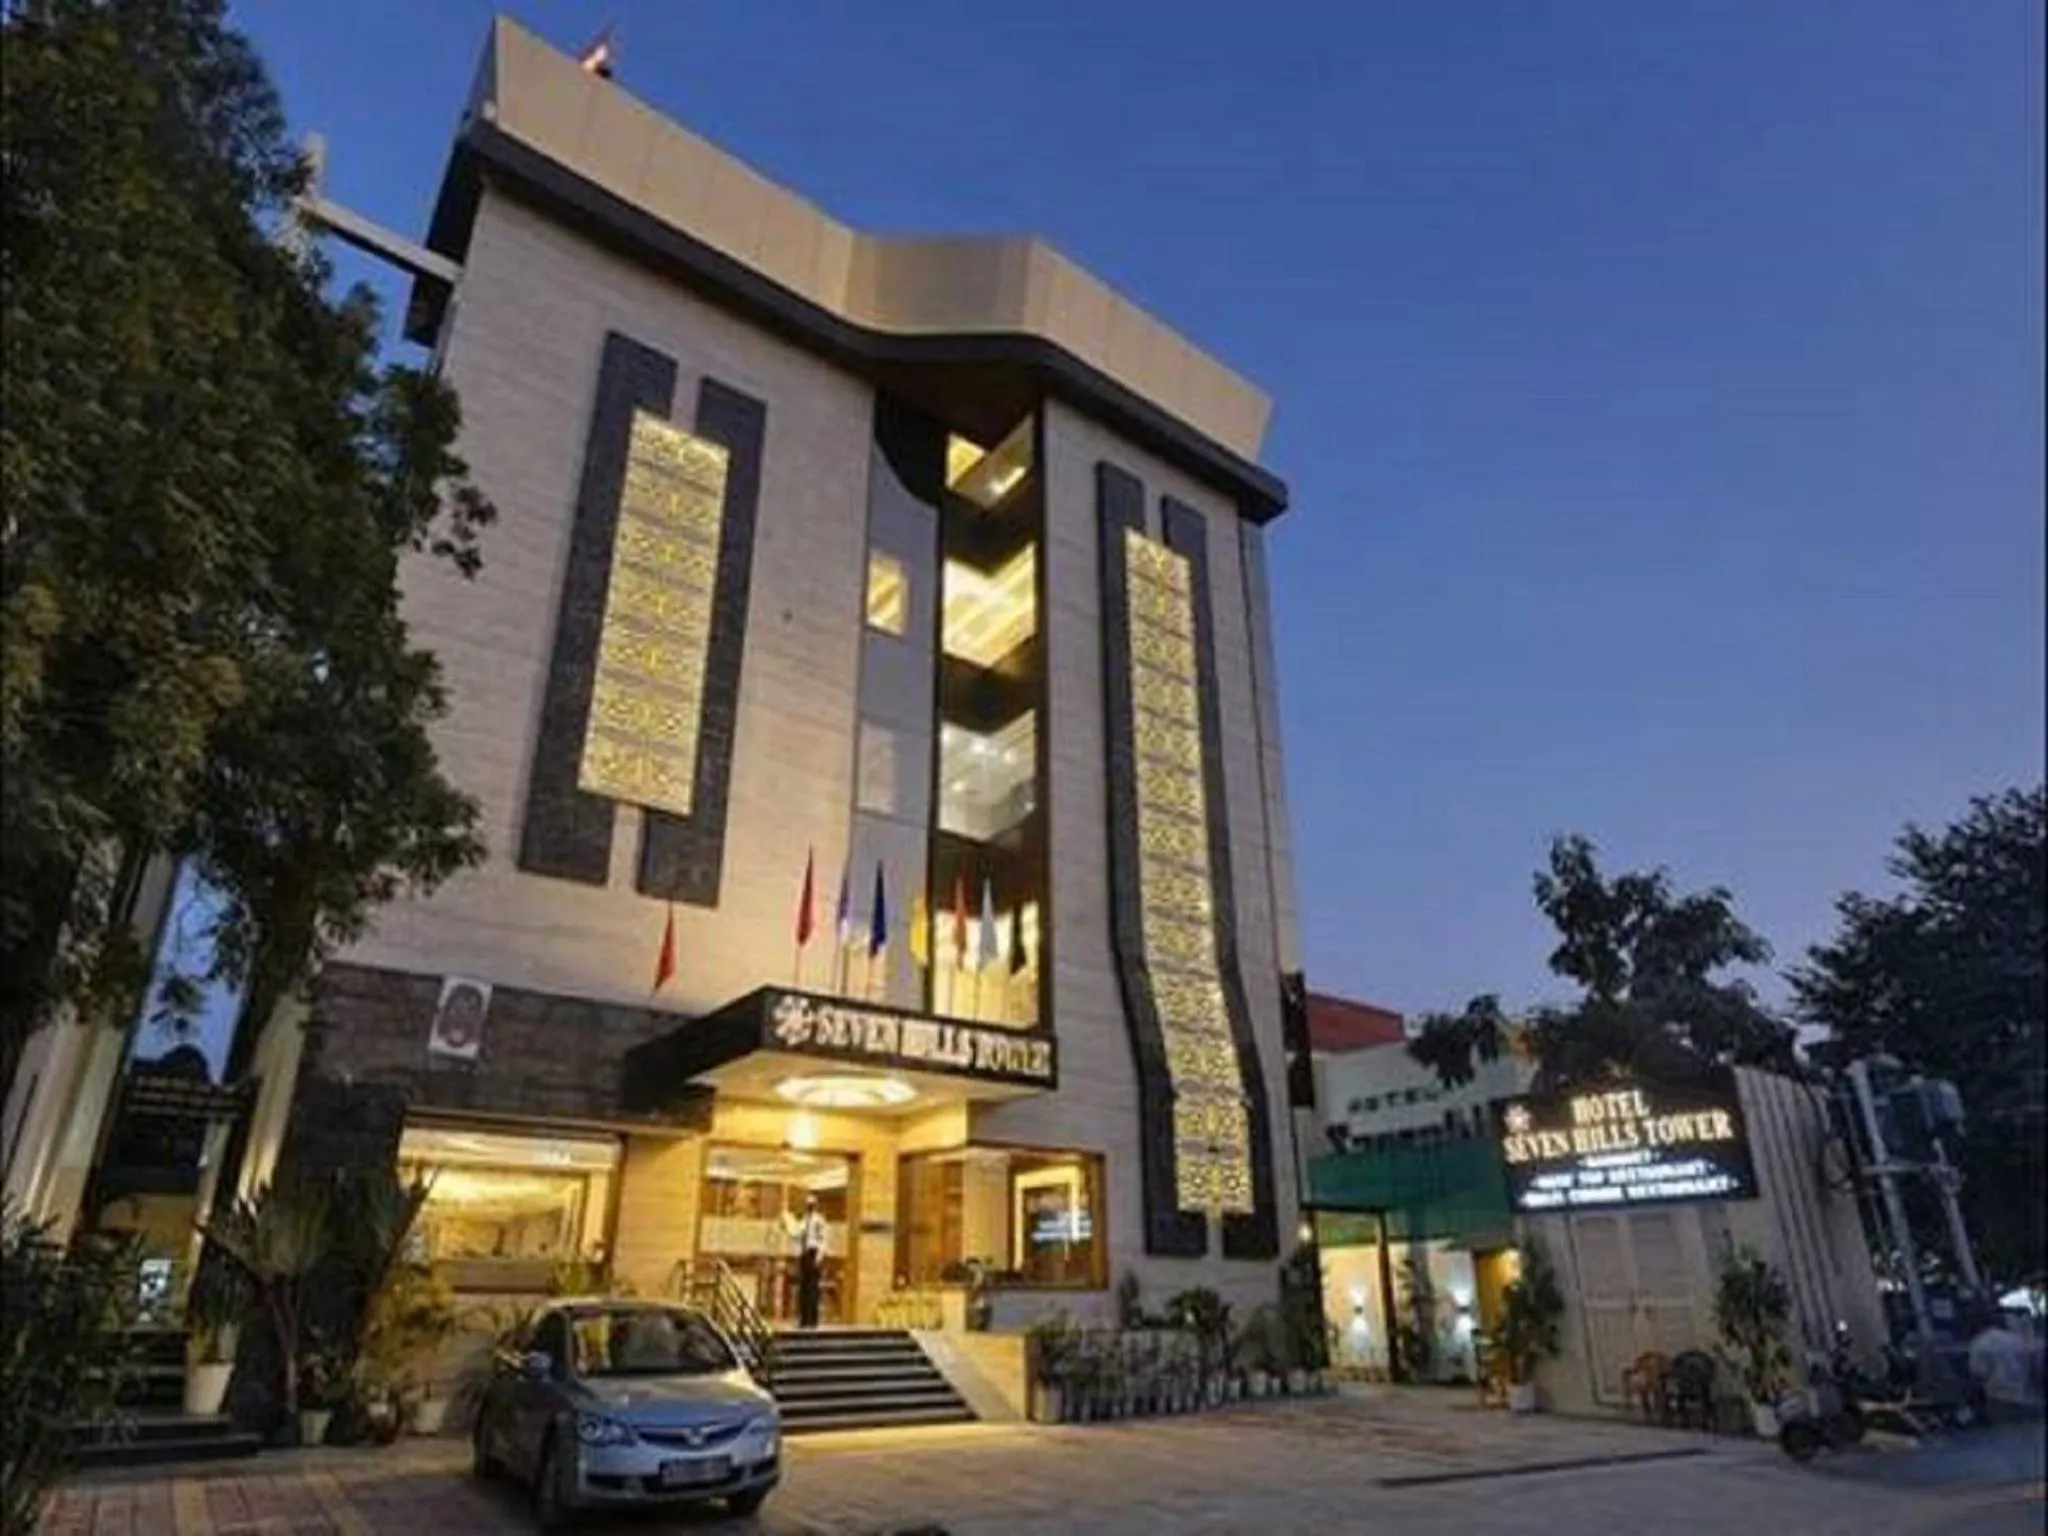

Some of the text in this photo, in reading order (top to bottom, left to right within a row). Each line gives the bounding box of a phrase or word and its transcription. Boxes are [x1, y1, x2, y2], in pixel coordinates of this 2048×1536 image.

[816, 1005, 898, 1054] SEVEN
[900, 1019, 972, 1067] HILLS
[1571, 1090, 1649, 1124] HOTEL
[1503, 1130, 1570, 1164] SEVEN
[1572, 1118, 1639, 1154] HILLS
[1643, 1109, 1733, 1147] TOWER
